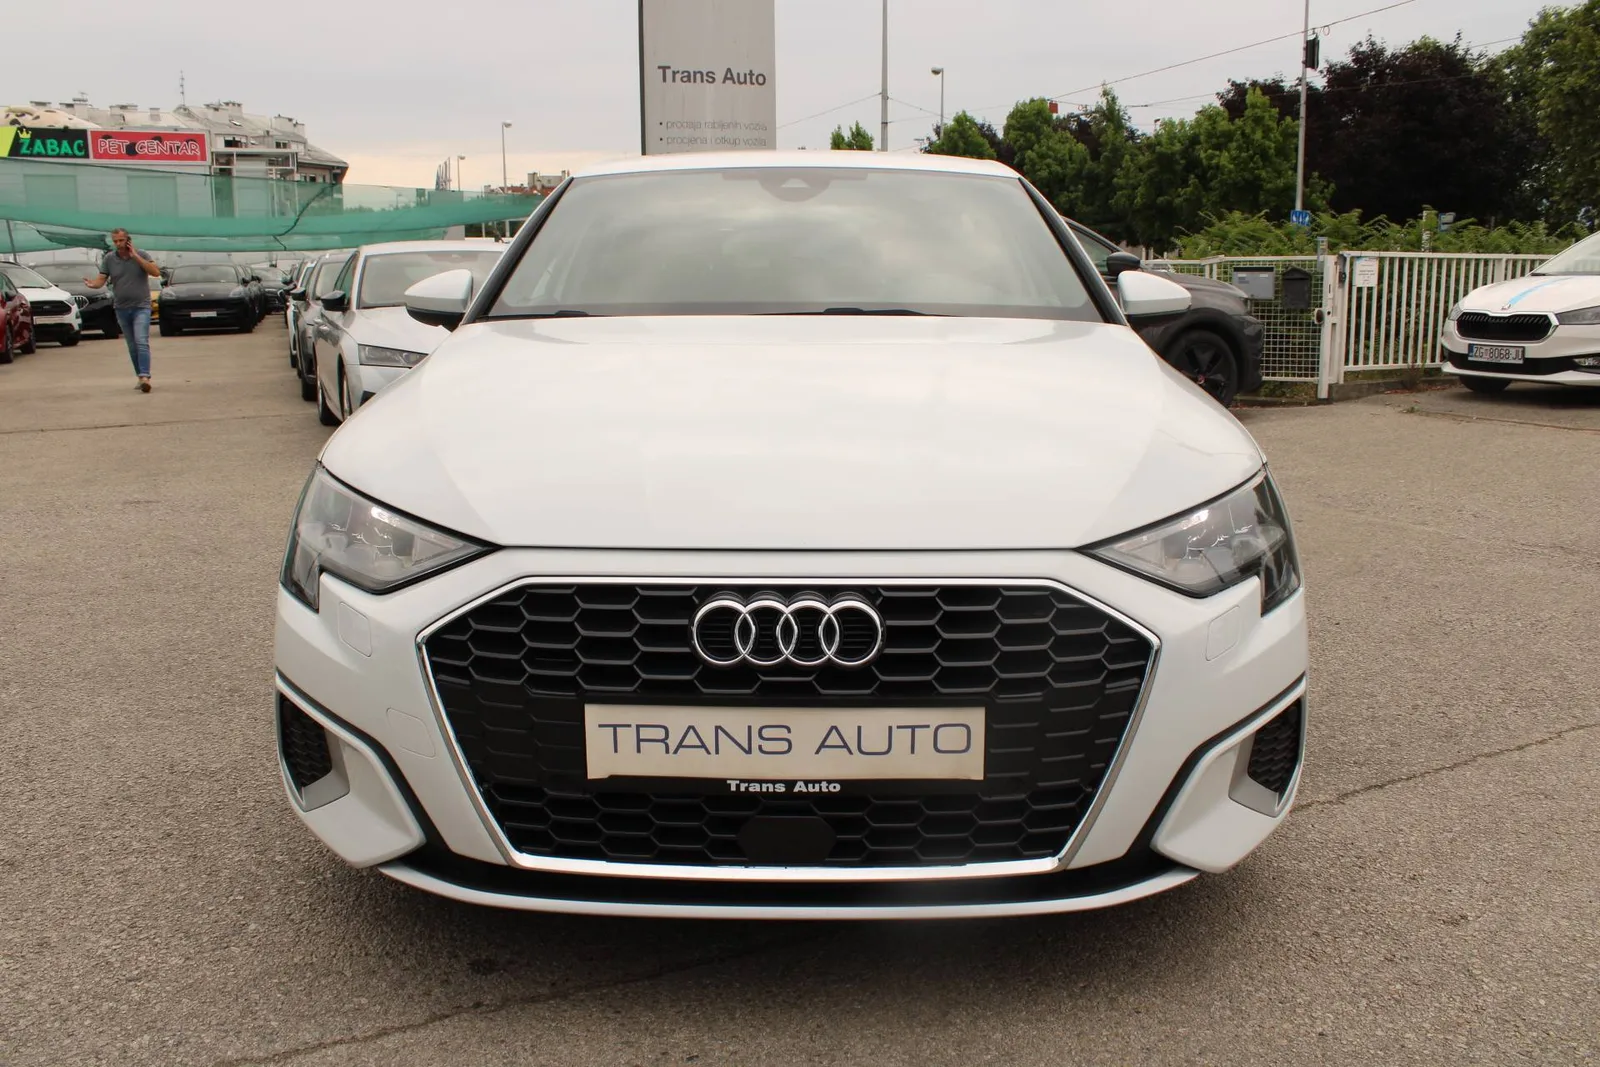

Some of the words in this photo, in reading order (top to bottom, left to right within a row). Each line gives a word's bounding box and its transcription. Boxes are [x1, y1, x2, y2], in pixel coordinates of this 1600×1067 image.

[657, 65, 716, 84] Trans
[721, 67, 767, 86] Auto
[98, 138, 130, 155] PET
[135, 140, 201, 156] CENTAR
[1474, 346, 1484, 358] ZG
[598, 723, 793, 756] TRANS
[814, 722, 972, 756] AUTO
[727, 780, 786, 793] Trans
[793, 781, 841, 793] Auto
